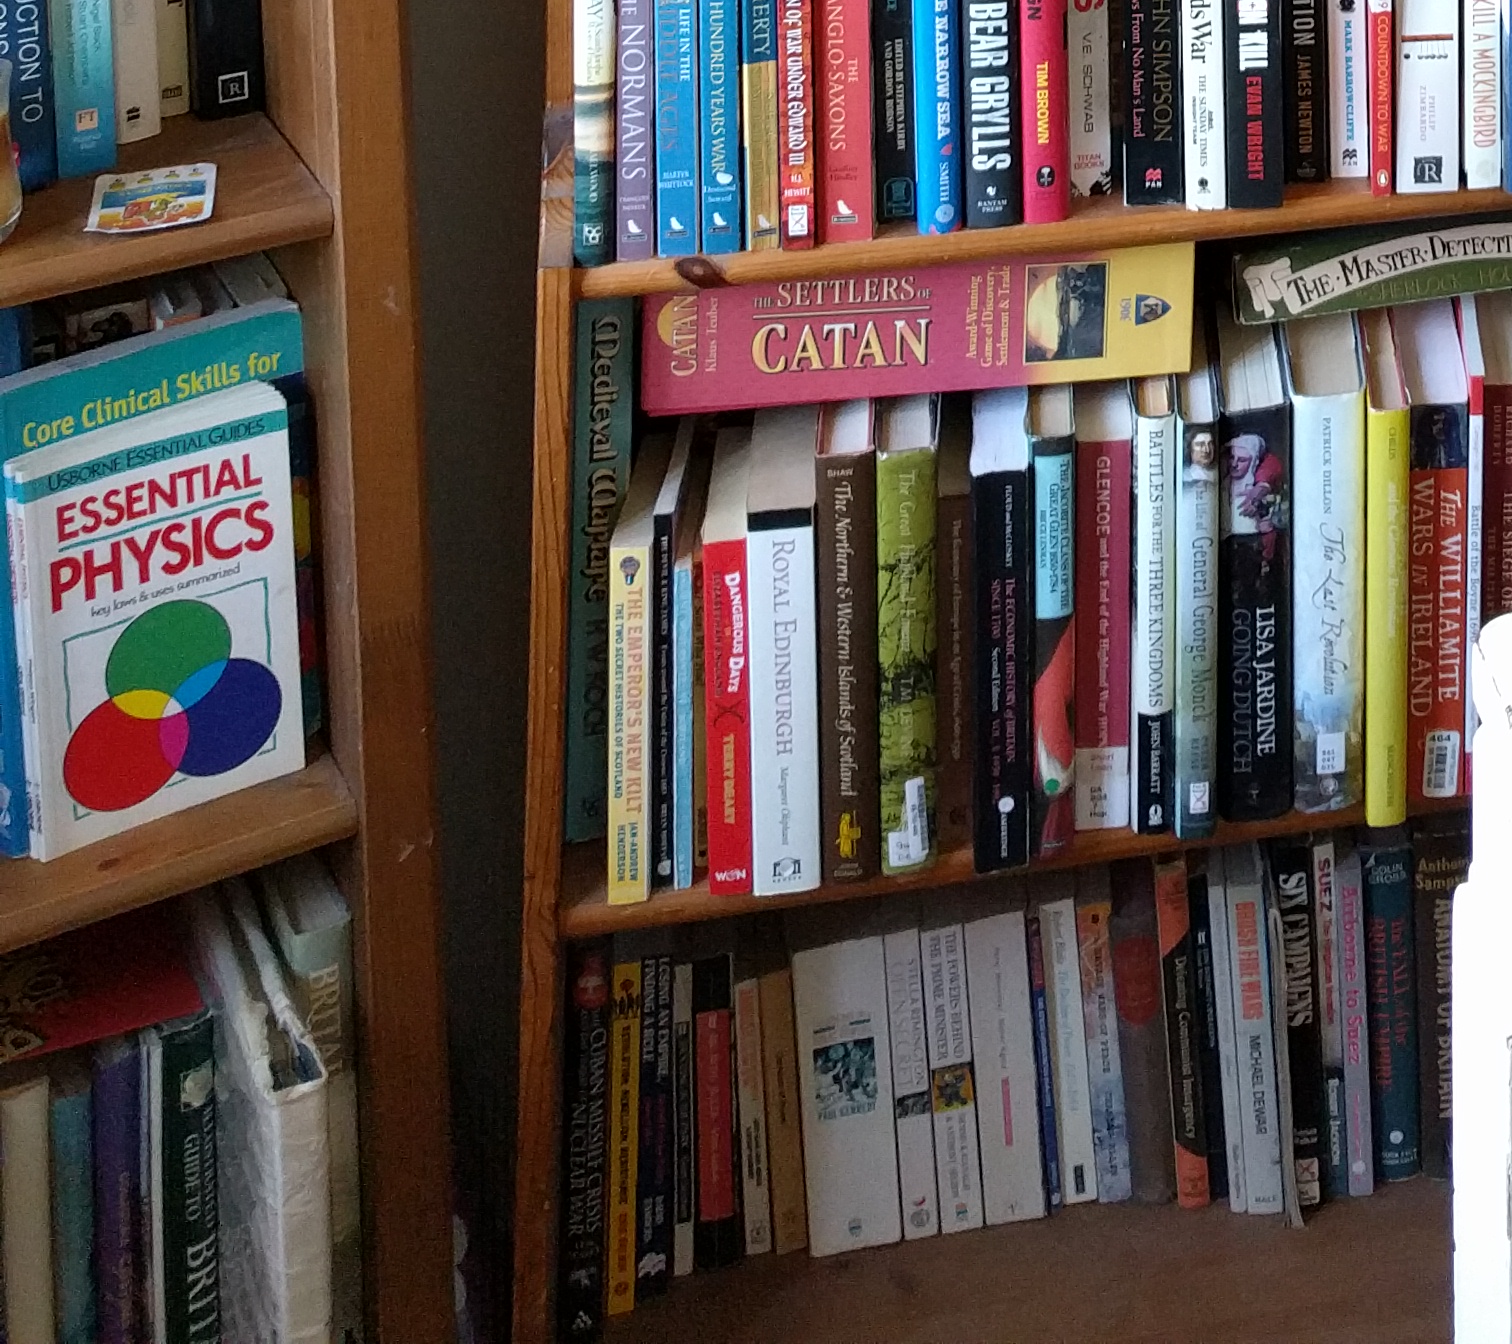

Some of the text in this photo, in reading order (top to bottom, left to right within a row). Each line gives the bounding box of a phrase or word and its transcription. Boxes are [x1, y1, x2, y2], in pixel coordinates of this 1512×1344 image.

[968, 1, 1008, 64] BEAR
[1189, 20, 1213, 64] War
[969, 70, 1010, 172] GRYLLS
[776, 277, 916, 307] SETTLERS
[1287, 273, 1333, 305] THE
[750, 317, 933, 374] CATAN
[22, 352, 281, 447] Core Clinical Skills for
[55, 454, 263, 543] ESSENTIAL
[49, 502, 276, 613] PHYSICS
